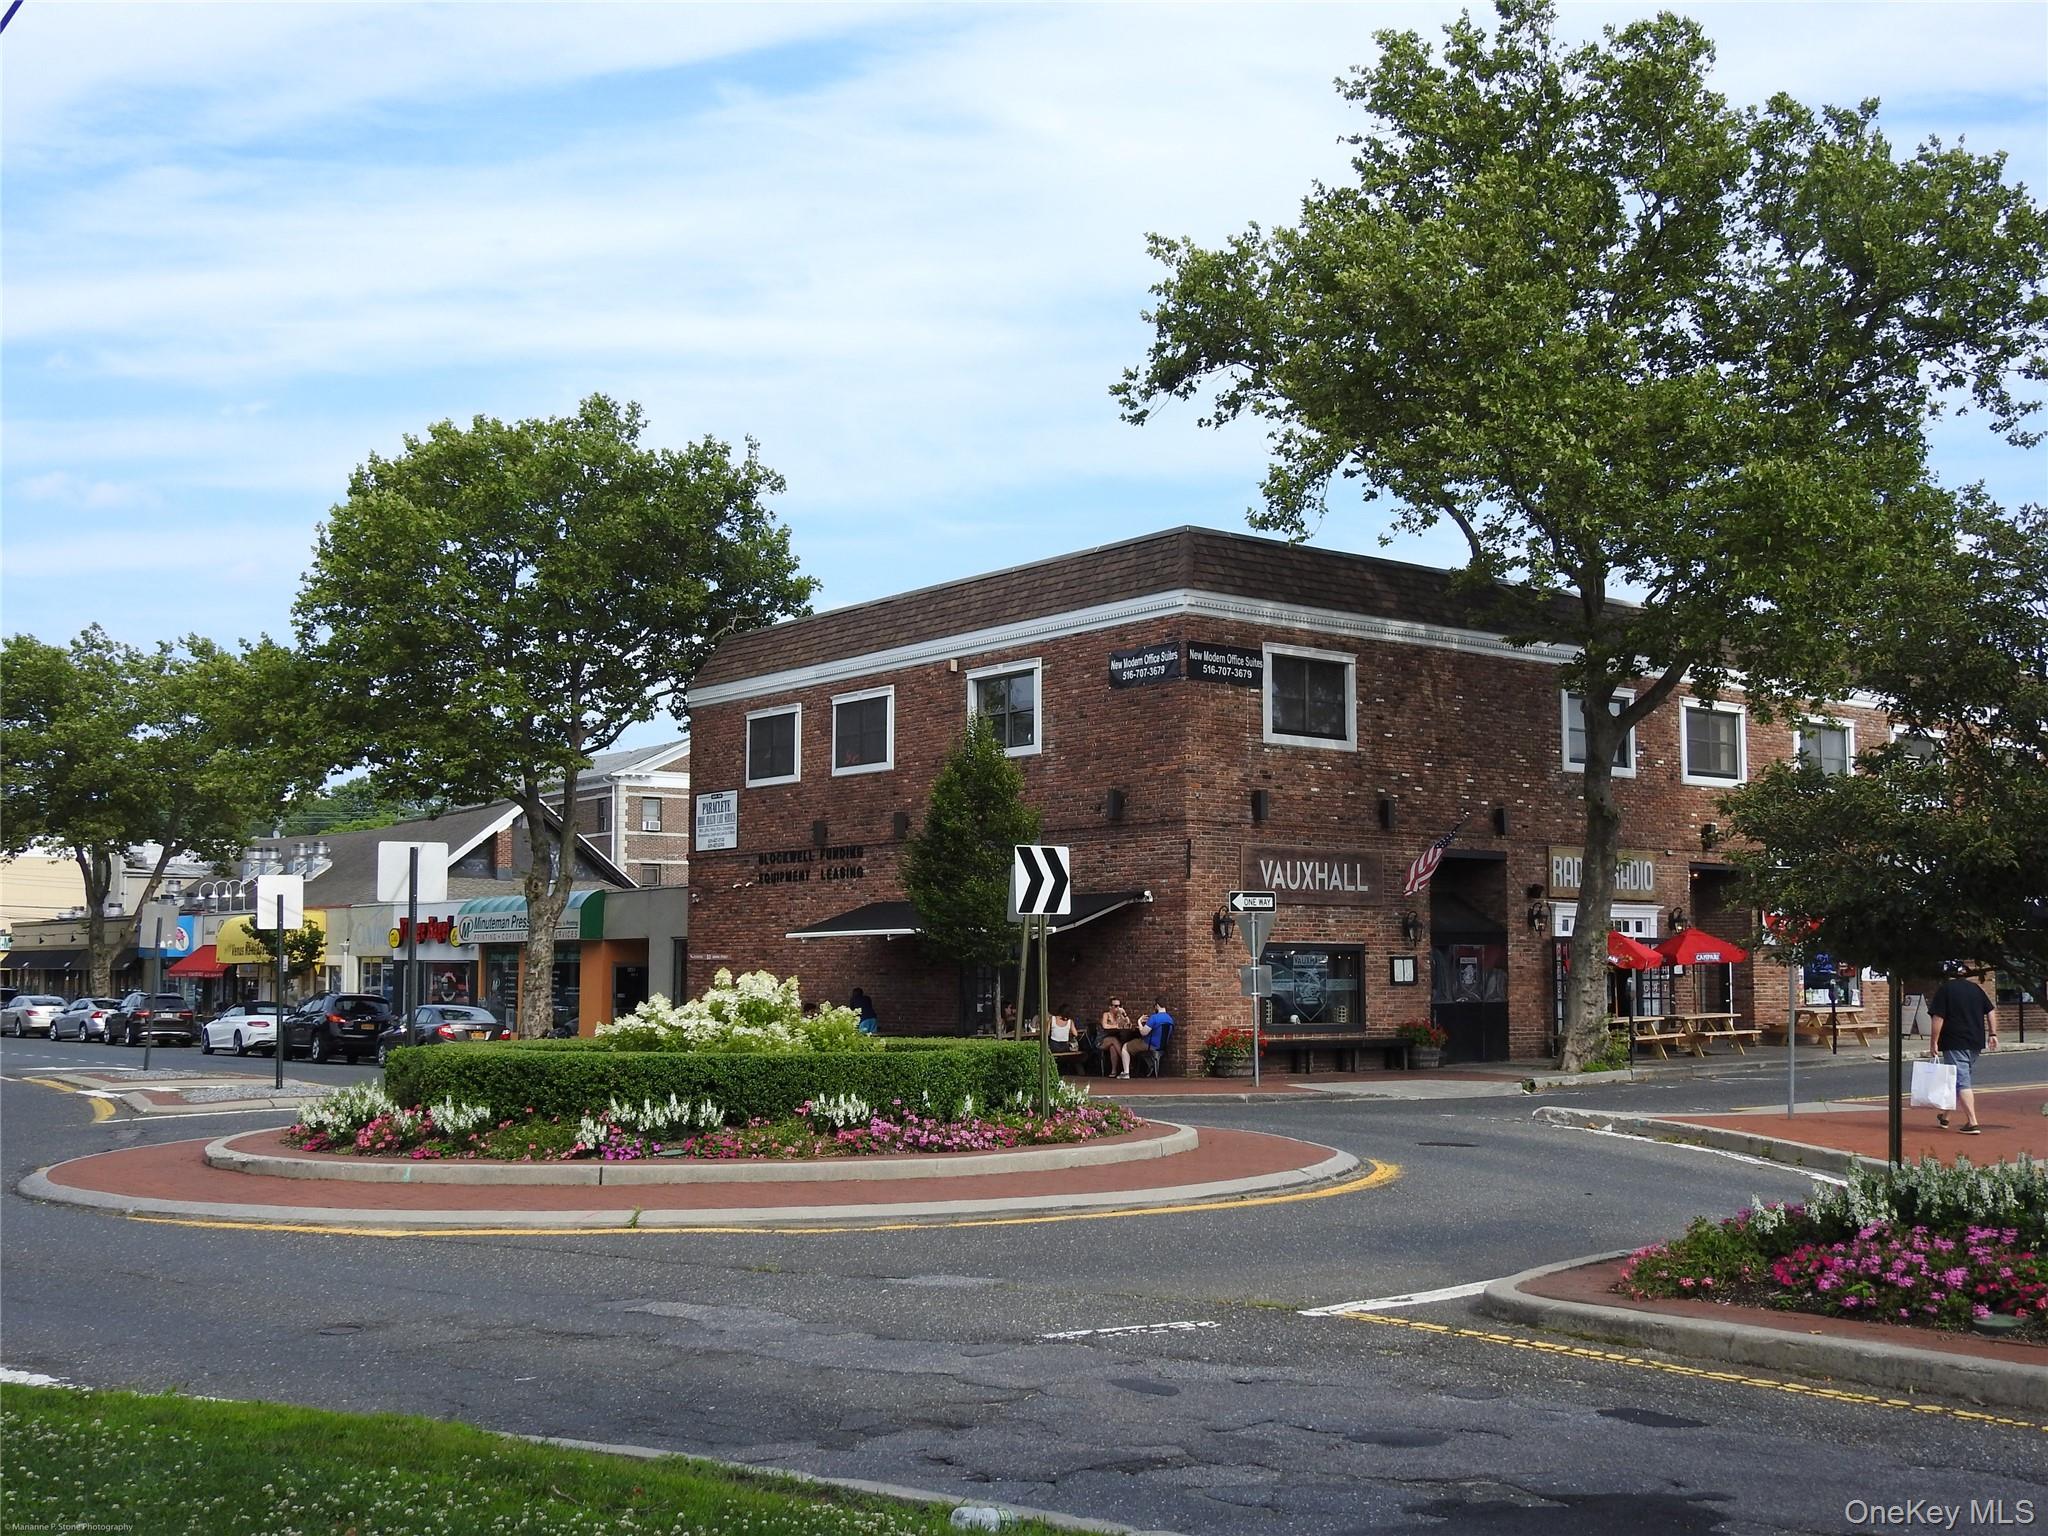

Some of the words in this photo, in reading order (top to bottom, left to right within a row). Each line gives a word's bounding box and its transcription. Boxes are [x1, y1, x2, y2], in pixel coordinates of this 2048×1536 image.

[1110, 660, 1122, 671] New
[1123, 657, 1143, 669] Modern
[1144, 653, 1160, 665] Office
[1160, 650, 1178, 661] Suites
[1189, 648, 1203, 660] New
[1203, 650, 1226, 662] Modern
[1226, 653, 1244, 665] Office
[1245, 656, 1263, 669] Suites
[1122, 665, 1165, 680] 516-707-3679
[1202, 664, 1252, 679] 516-707-3679
[758, 869, 810, 885] EQUIPMENT
[820, 865, 864, 880] LEASING
[1260, 859, 1369, 892] VAUXHALL
[1243, 898, 1257, 906] ONE
[1258, 898, 1271, 906] WAY
[474, 916, 510, 930] Minuteman
